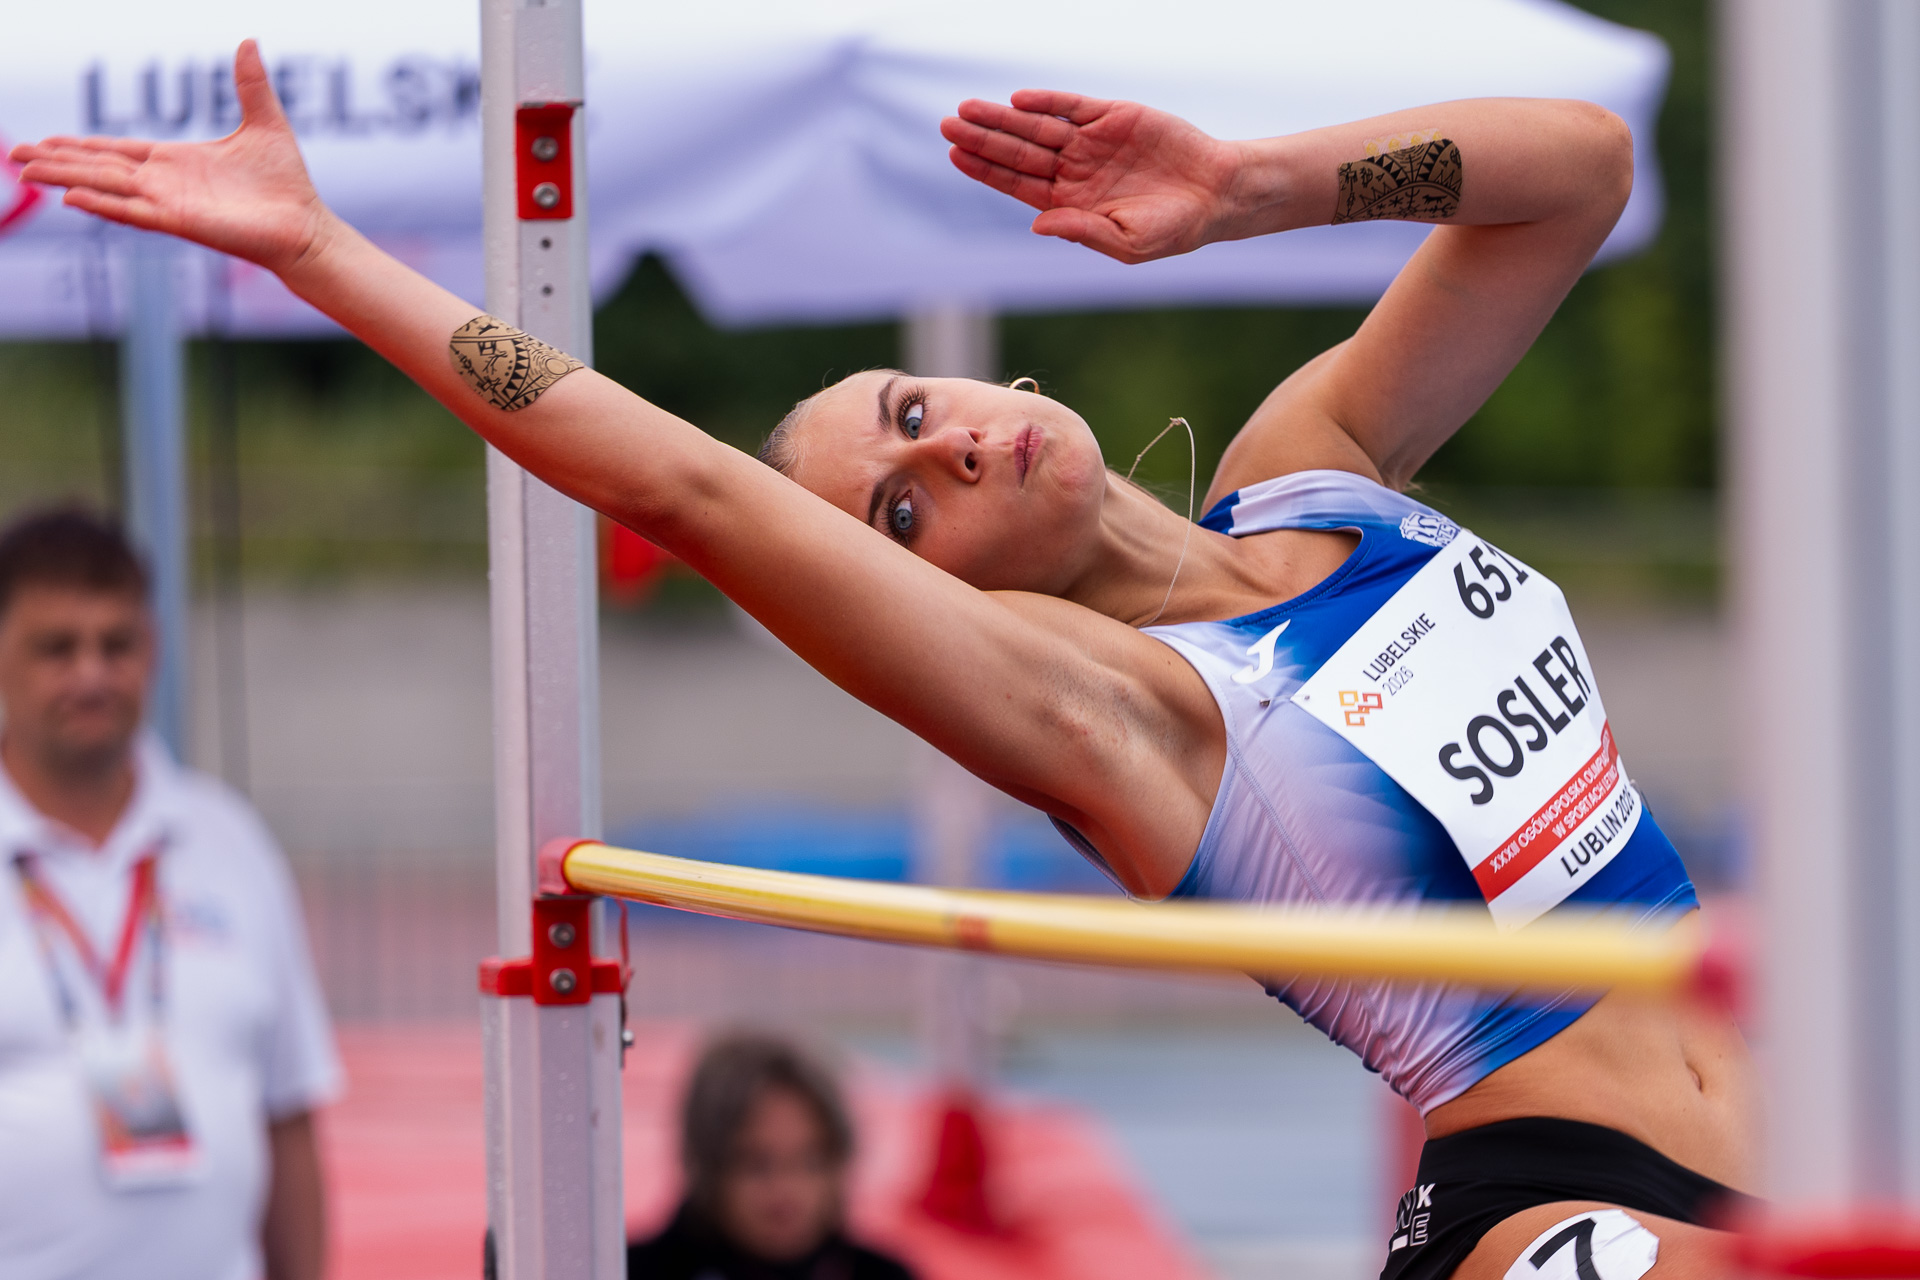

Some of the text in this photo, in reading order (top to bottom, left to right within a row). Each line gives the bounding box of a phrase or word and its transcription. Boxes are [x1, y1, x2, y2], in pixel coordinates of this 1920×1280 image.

[1453, 541, 1529, 619] 651
[1362, 612, 1436, 682] LUBELSKIE
[1382, 665, 1414, 696] 2026
[1438, 635, 1591, 806] SOSLER
[1517, 776, 1588, 848] OGÓLNOPOLSKA
[1551, 823, 1567, 840] W
[1563, 778, 1607, 829] SPORTACH
[1560, 808, 1623, 879] LUBLIN
[1529, 1217, 1602, 1280] 7
